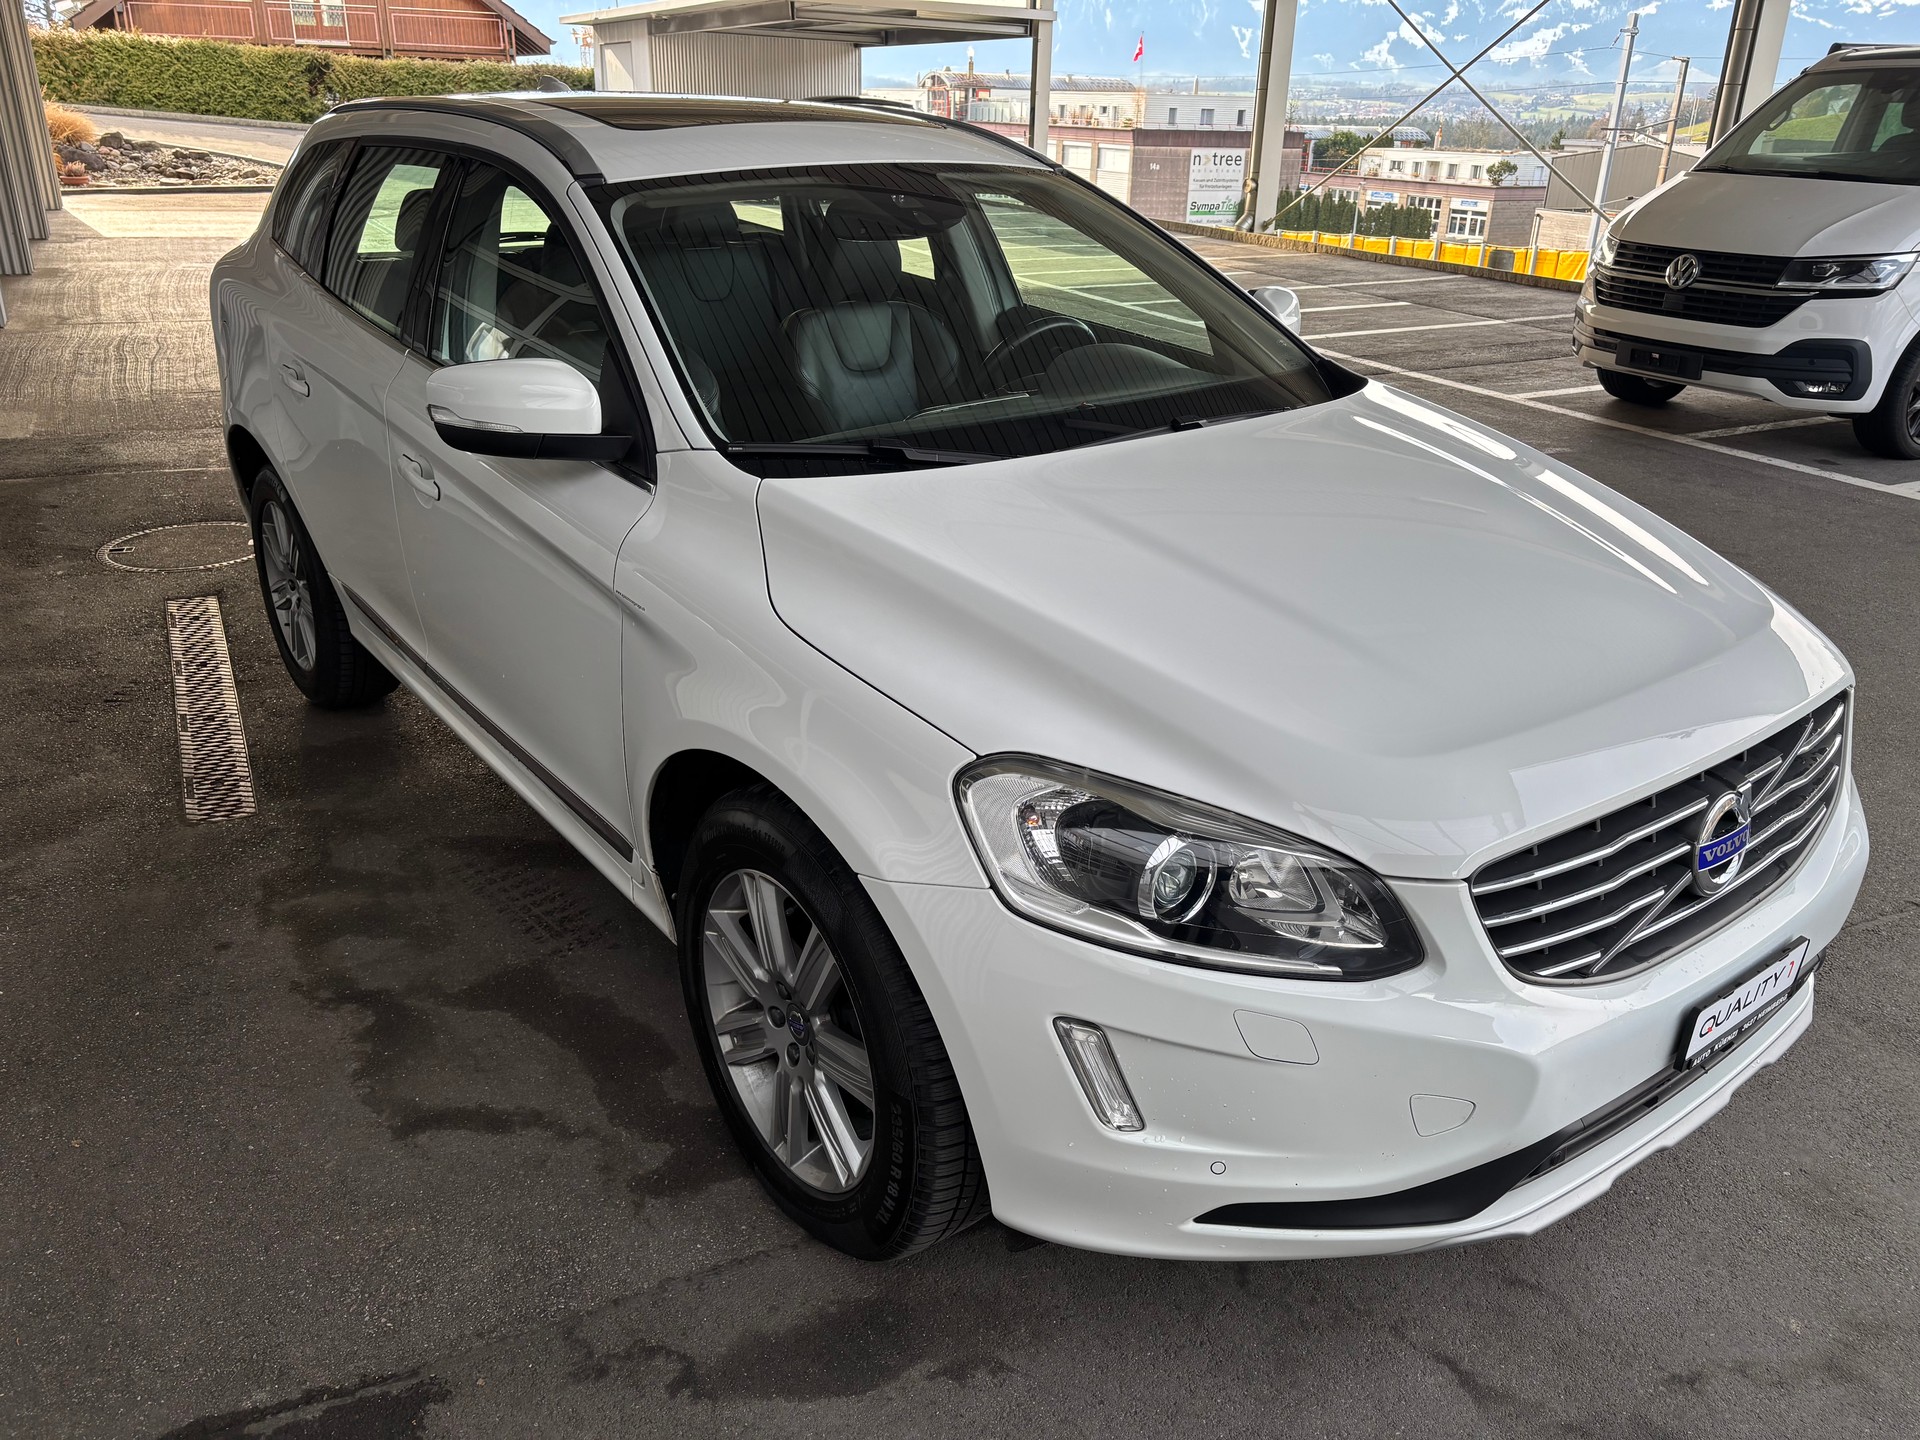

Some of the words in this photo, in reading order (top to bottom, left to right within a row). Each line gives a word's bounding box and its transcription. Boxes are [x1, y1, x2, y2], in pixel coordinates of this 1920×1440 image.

[1703, 829, 1748, 862] VOLVO
[1692, 1049, 1711, 1067] AUTO
[886, 1181, 901, 1198] 18
